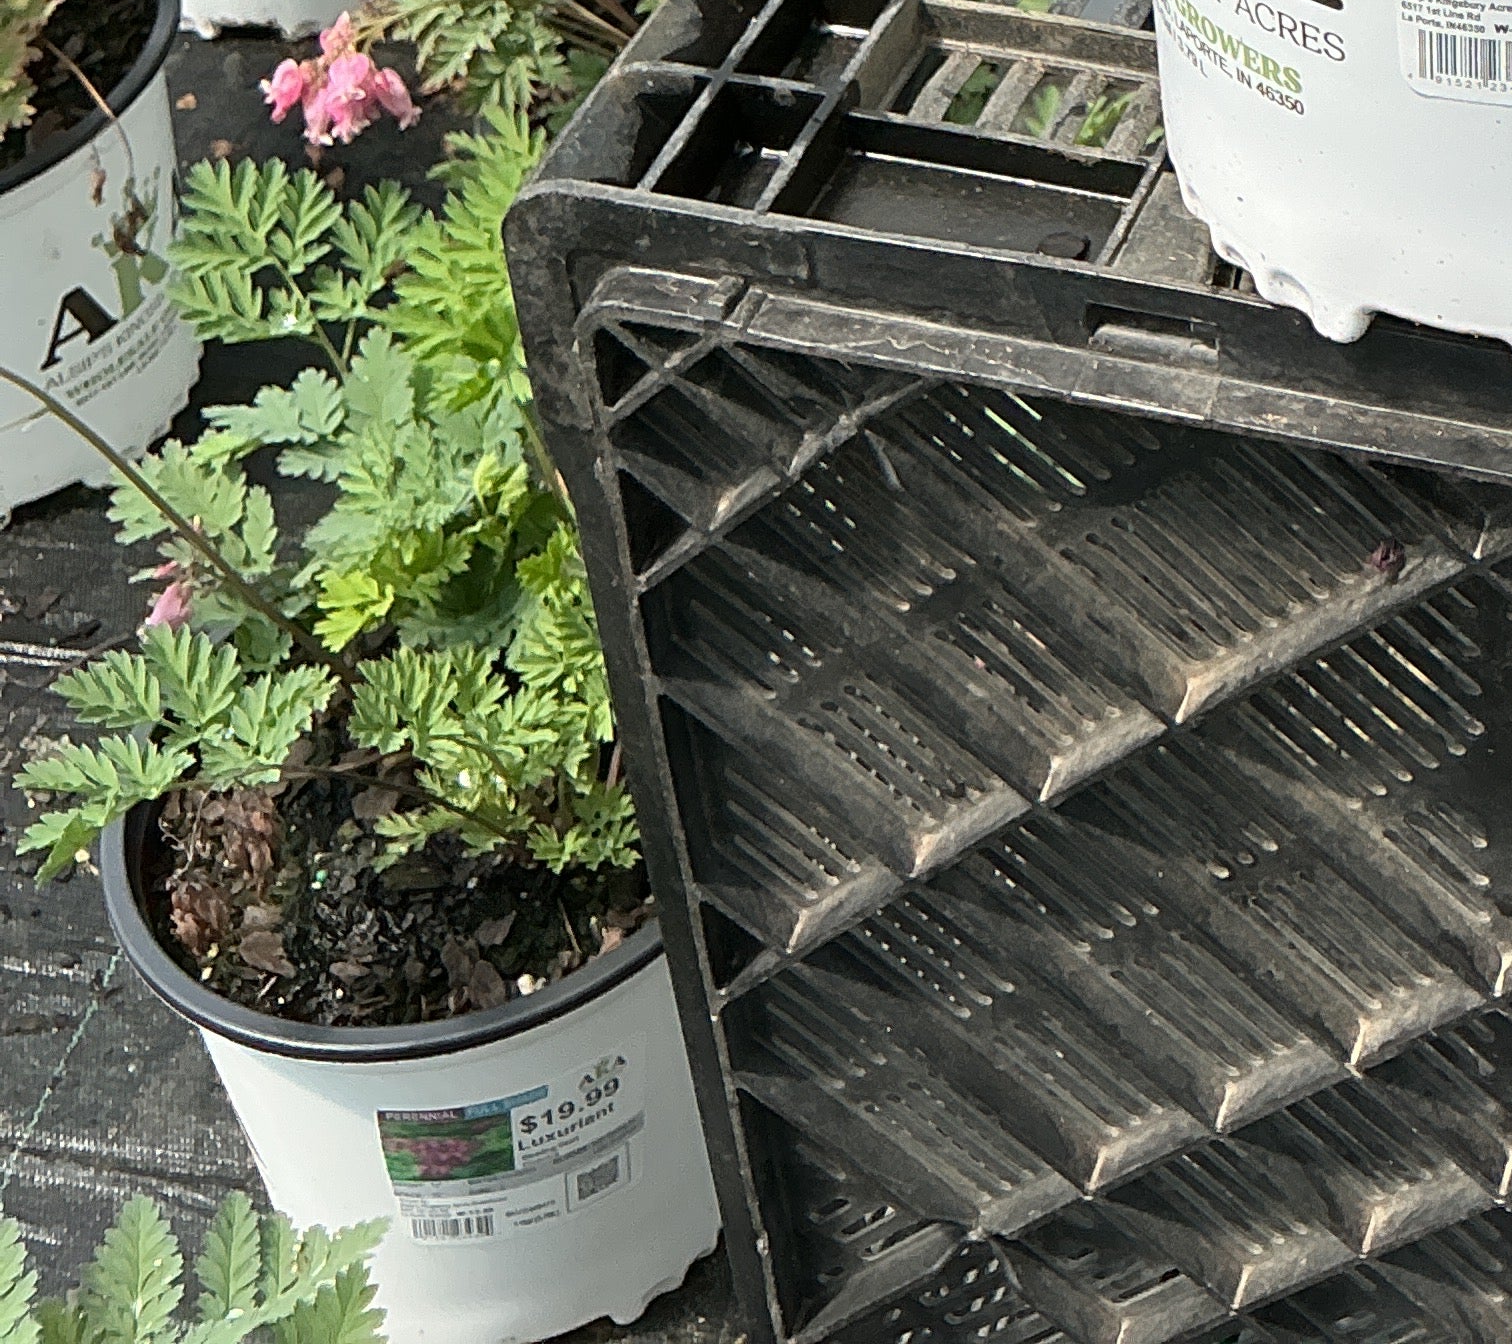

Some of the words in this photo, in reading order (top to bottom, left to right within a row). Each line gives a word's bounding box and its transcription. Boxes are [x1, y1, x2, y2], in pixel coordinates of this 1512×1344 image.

[1401, 11, 1413, 22] La
[1466, 11, 1481, 22] Rd
[1236, 66, 1253, 90] IN
[1256, 81, 1305, 116] 46350
[519, 1077, 621, 1135] $19.99
